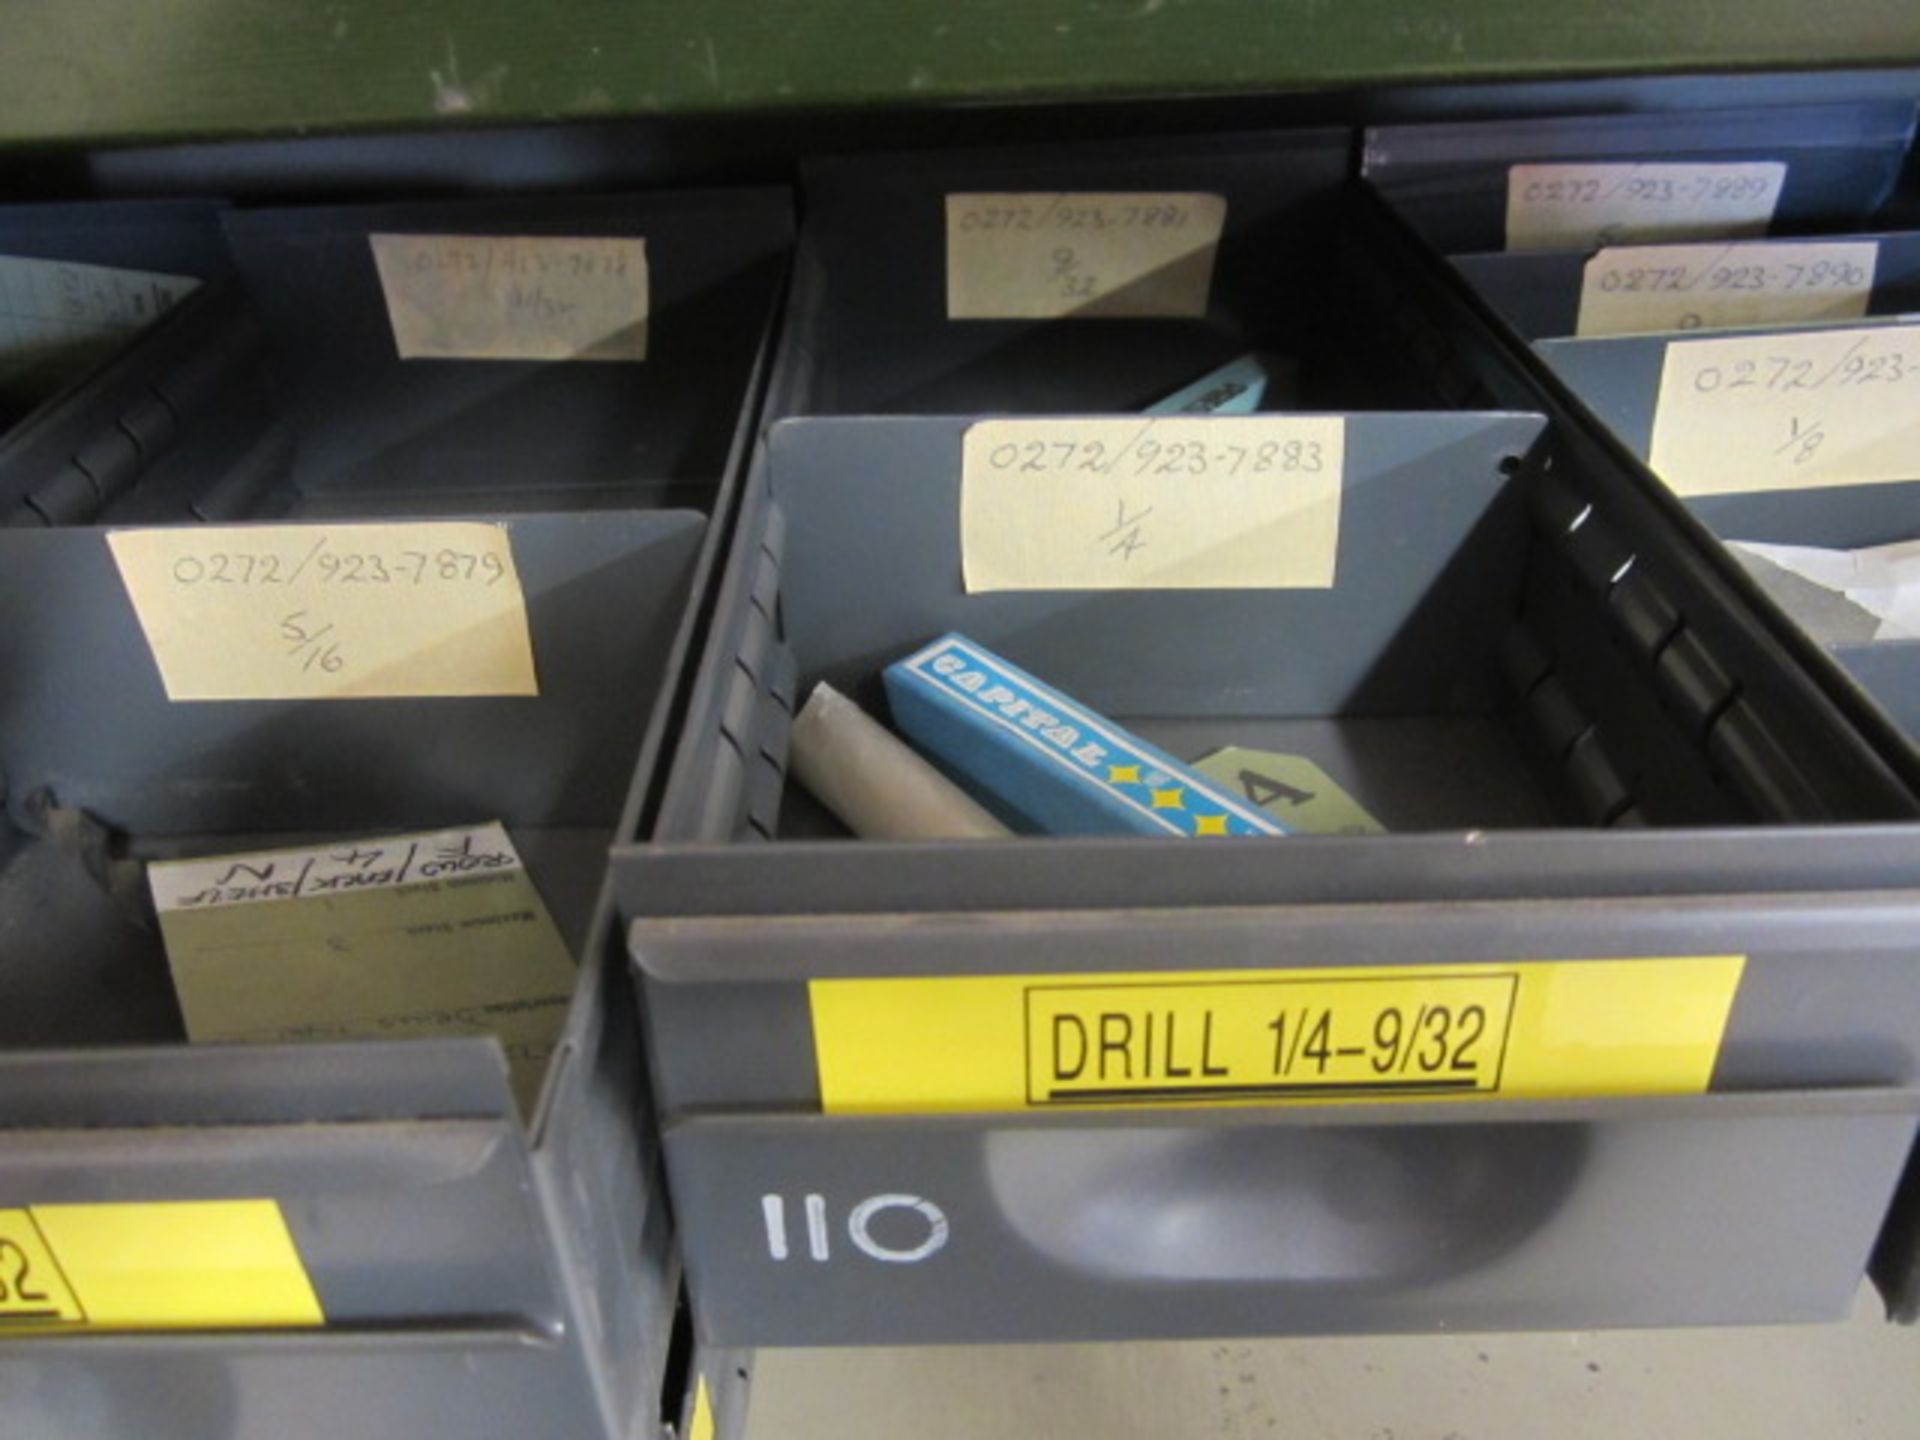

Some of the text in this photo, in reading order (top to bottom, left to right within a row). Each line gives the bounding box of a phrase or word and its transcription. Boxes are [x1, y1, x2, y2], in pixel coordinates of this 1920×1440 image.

[989, 418, 1325, 477] 0272/923-7883
[1773, 416, 1826, 466] 1/8
[172, 536, 505, 587] 0272/923-7879
[280, 610, 345, 674] 5/16
[930, 653, 1108, 768] CAPITAL
[1053, 1002, 1488, 1081] DRILL 1/4-9/32
[760, 1192, 950, 1263] 110
